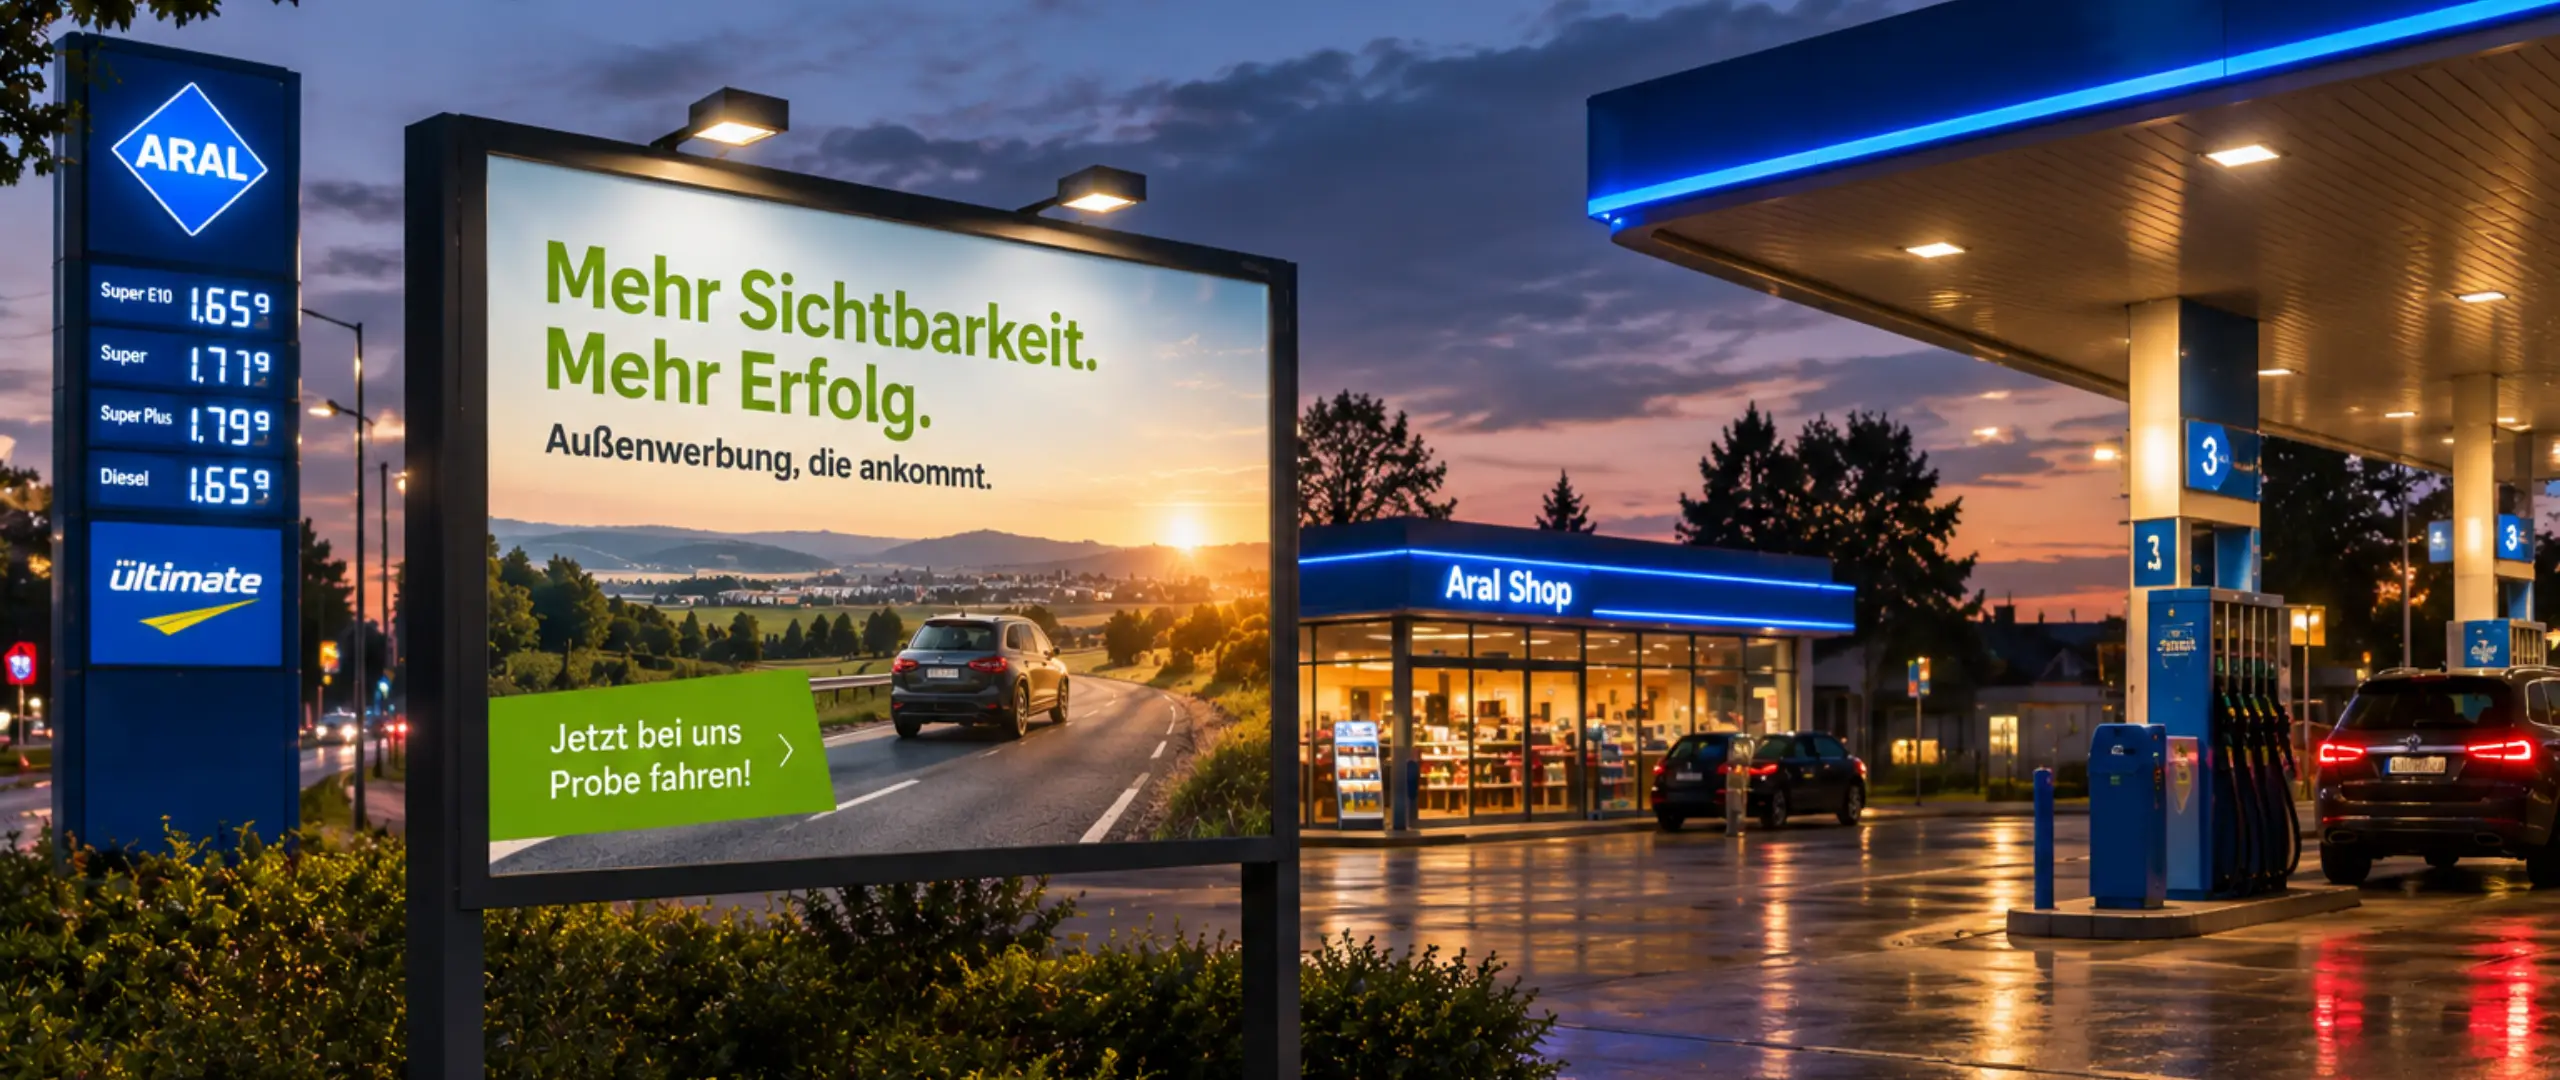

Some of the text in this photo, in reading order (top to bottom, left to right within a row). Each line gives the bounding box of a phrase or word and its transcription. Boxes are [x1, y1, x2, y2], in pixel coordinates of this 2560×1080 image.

[135, 133, 248, 182] ARAL
[101, 281, 145, 303] Super
[147, 287, 173, 304] E10
[546, 239, 1098, 372] Mehr Sichtbarkeit.
[101, 344, 148, 366] Super
[546, 326, 931, 442] Mehr Erfolg.
[101, 404, 142, 426] Super
[144, 407, 173, 425] Plus
[545, 423, 992, 490] Außenwerbung, die ankommt.
[2201, 436, 2218, 476] 3
[101, 466, 149, 487] Diesel
[2505, 523, 2518, 552] 3
[1445, 564, 1573, 613] Aral Shop
[550, 718, 742, 755] Jetzt bei uns
[550, 758, 752, 800] Probe fahren!
